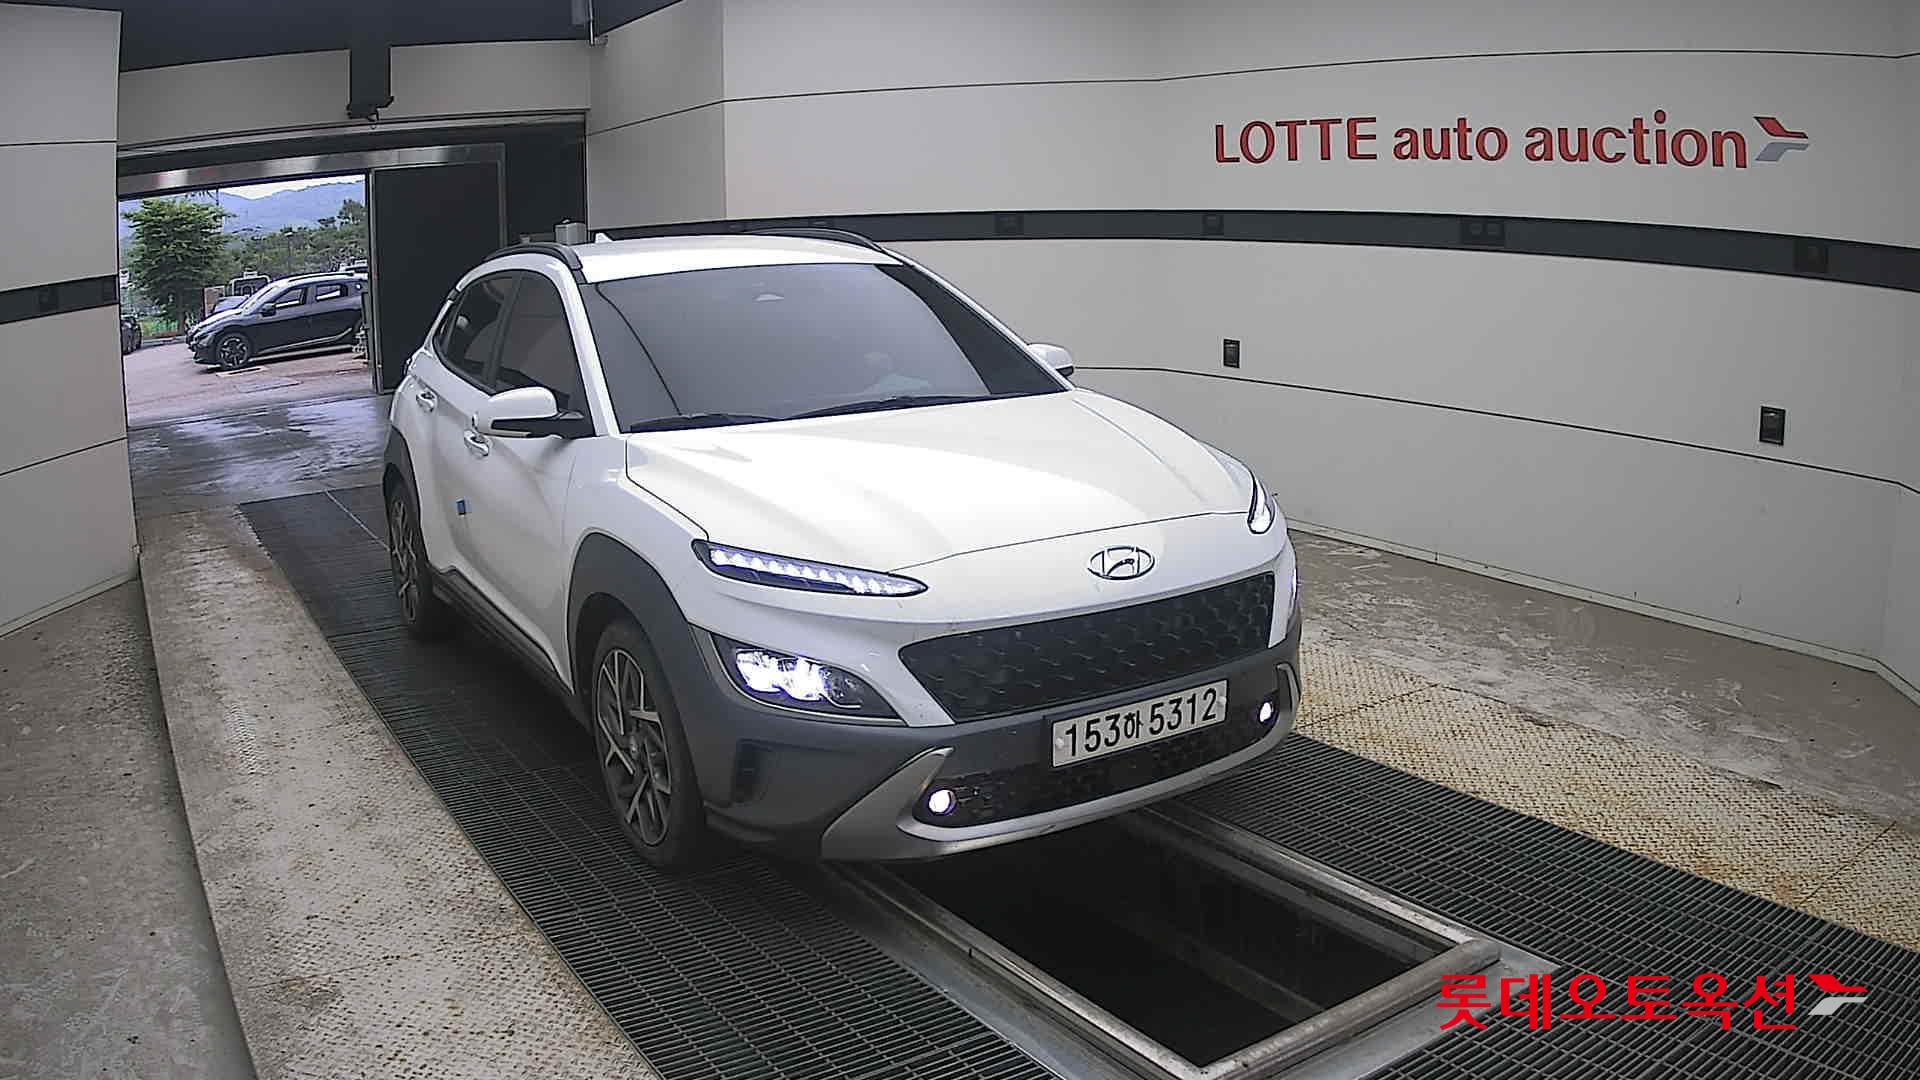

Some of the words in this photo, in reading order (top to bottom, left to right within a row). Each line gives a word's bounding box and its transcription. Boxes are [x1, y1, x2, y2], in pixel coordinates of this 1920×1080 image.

[1215, 117, 1377, 163] LOTTE
[1392, 117, 1508, 161] auto
[1524, 109, 1748, 168] auction
